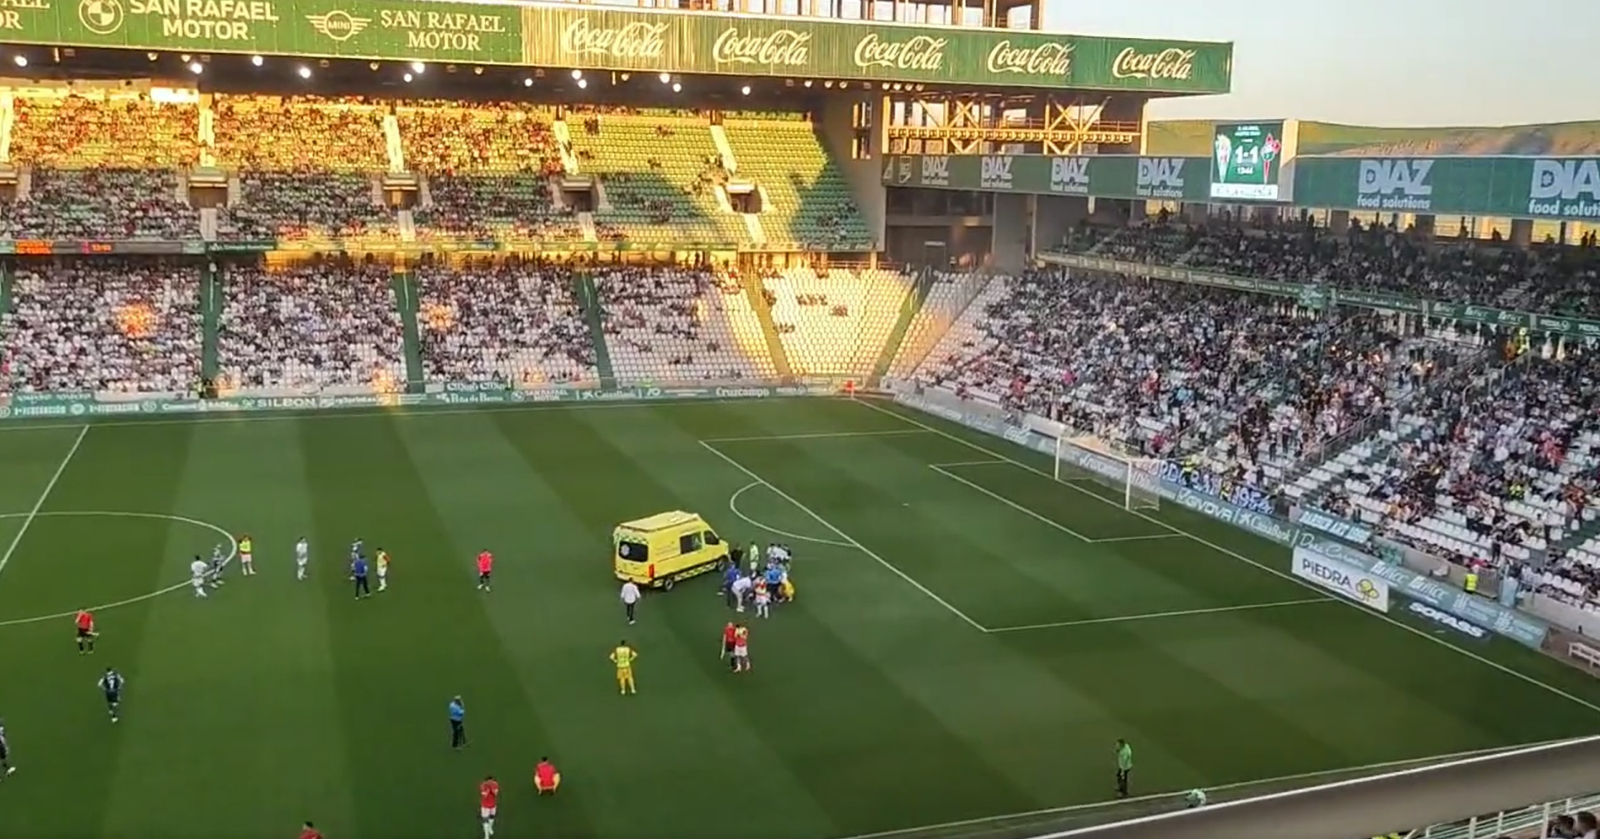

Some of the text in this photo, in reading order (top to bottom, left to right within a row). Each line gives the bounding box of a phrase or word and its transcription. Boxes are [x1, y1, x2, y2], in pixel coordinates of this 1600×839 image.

[130, 0, 279, 20] SAN RAFAEL
[163, 18, 248, 40] MOTOR
[328, 20, 350, 30] MINI
[381, 10, 506, 32] SAN RAFAEL
[409, 31, 481, 50] MOTOR
[1051, 158, 1089, 183] DIAZ
[1137, 158, 1185, 187] DIAZ
[1358, 159, 1435, 195] DIAZ
[1357, 195, 1431, 210] food solutions
[1529, 199, 1560, 214] food
[716, 386, 770, 398] Cruzcampo
[257, 397, 318, 408] SILBON
